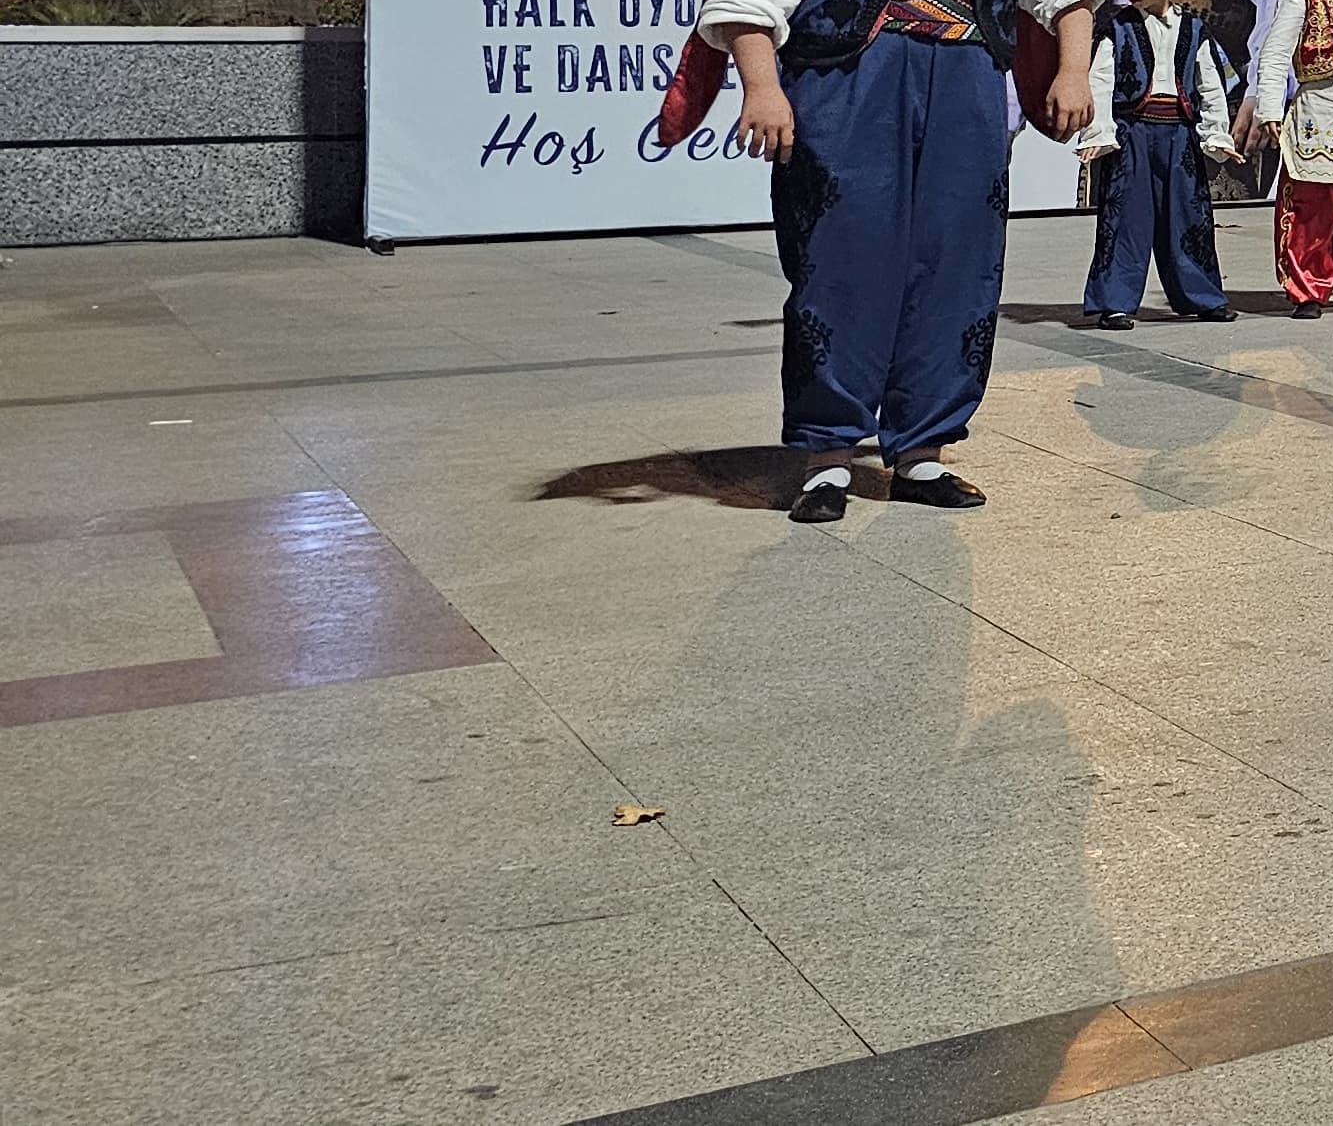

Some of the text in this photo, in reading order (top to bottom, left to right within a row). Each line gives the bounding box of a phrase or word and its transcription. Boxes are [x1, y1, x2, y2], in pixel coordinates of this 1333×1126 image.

[483, 43, 675, 93] VE DANS
[480, 112, 605, 174] Hoş
